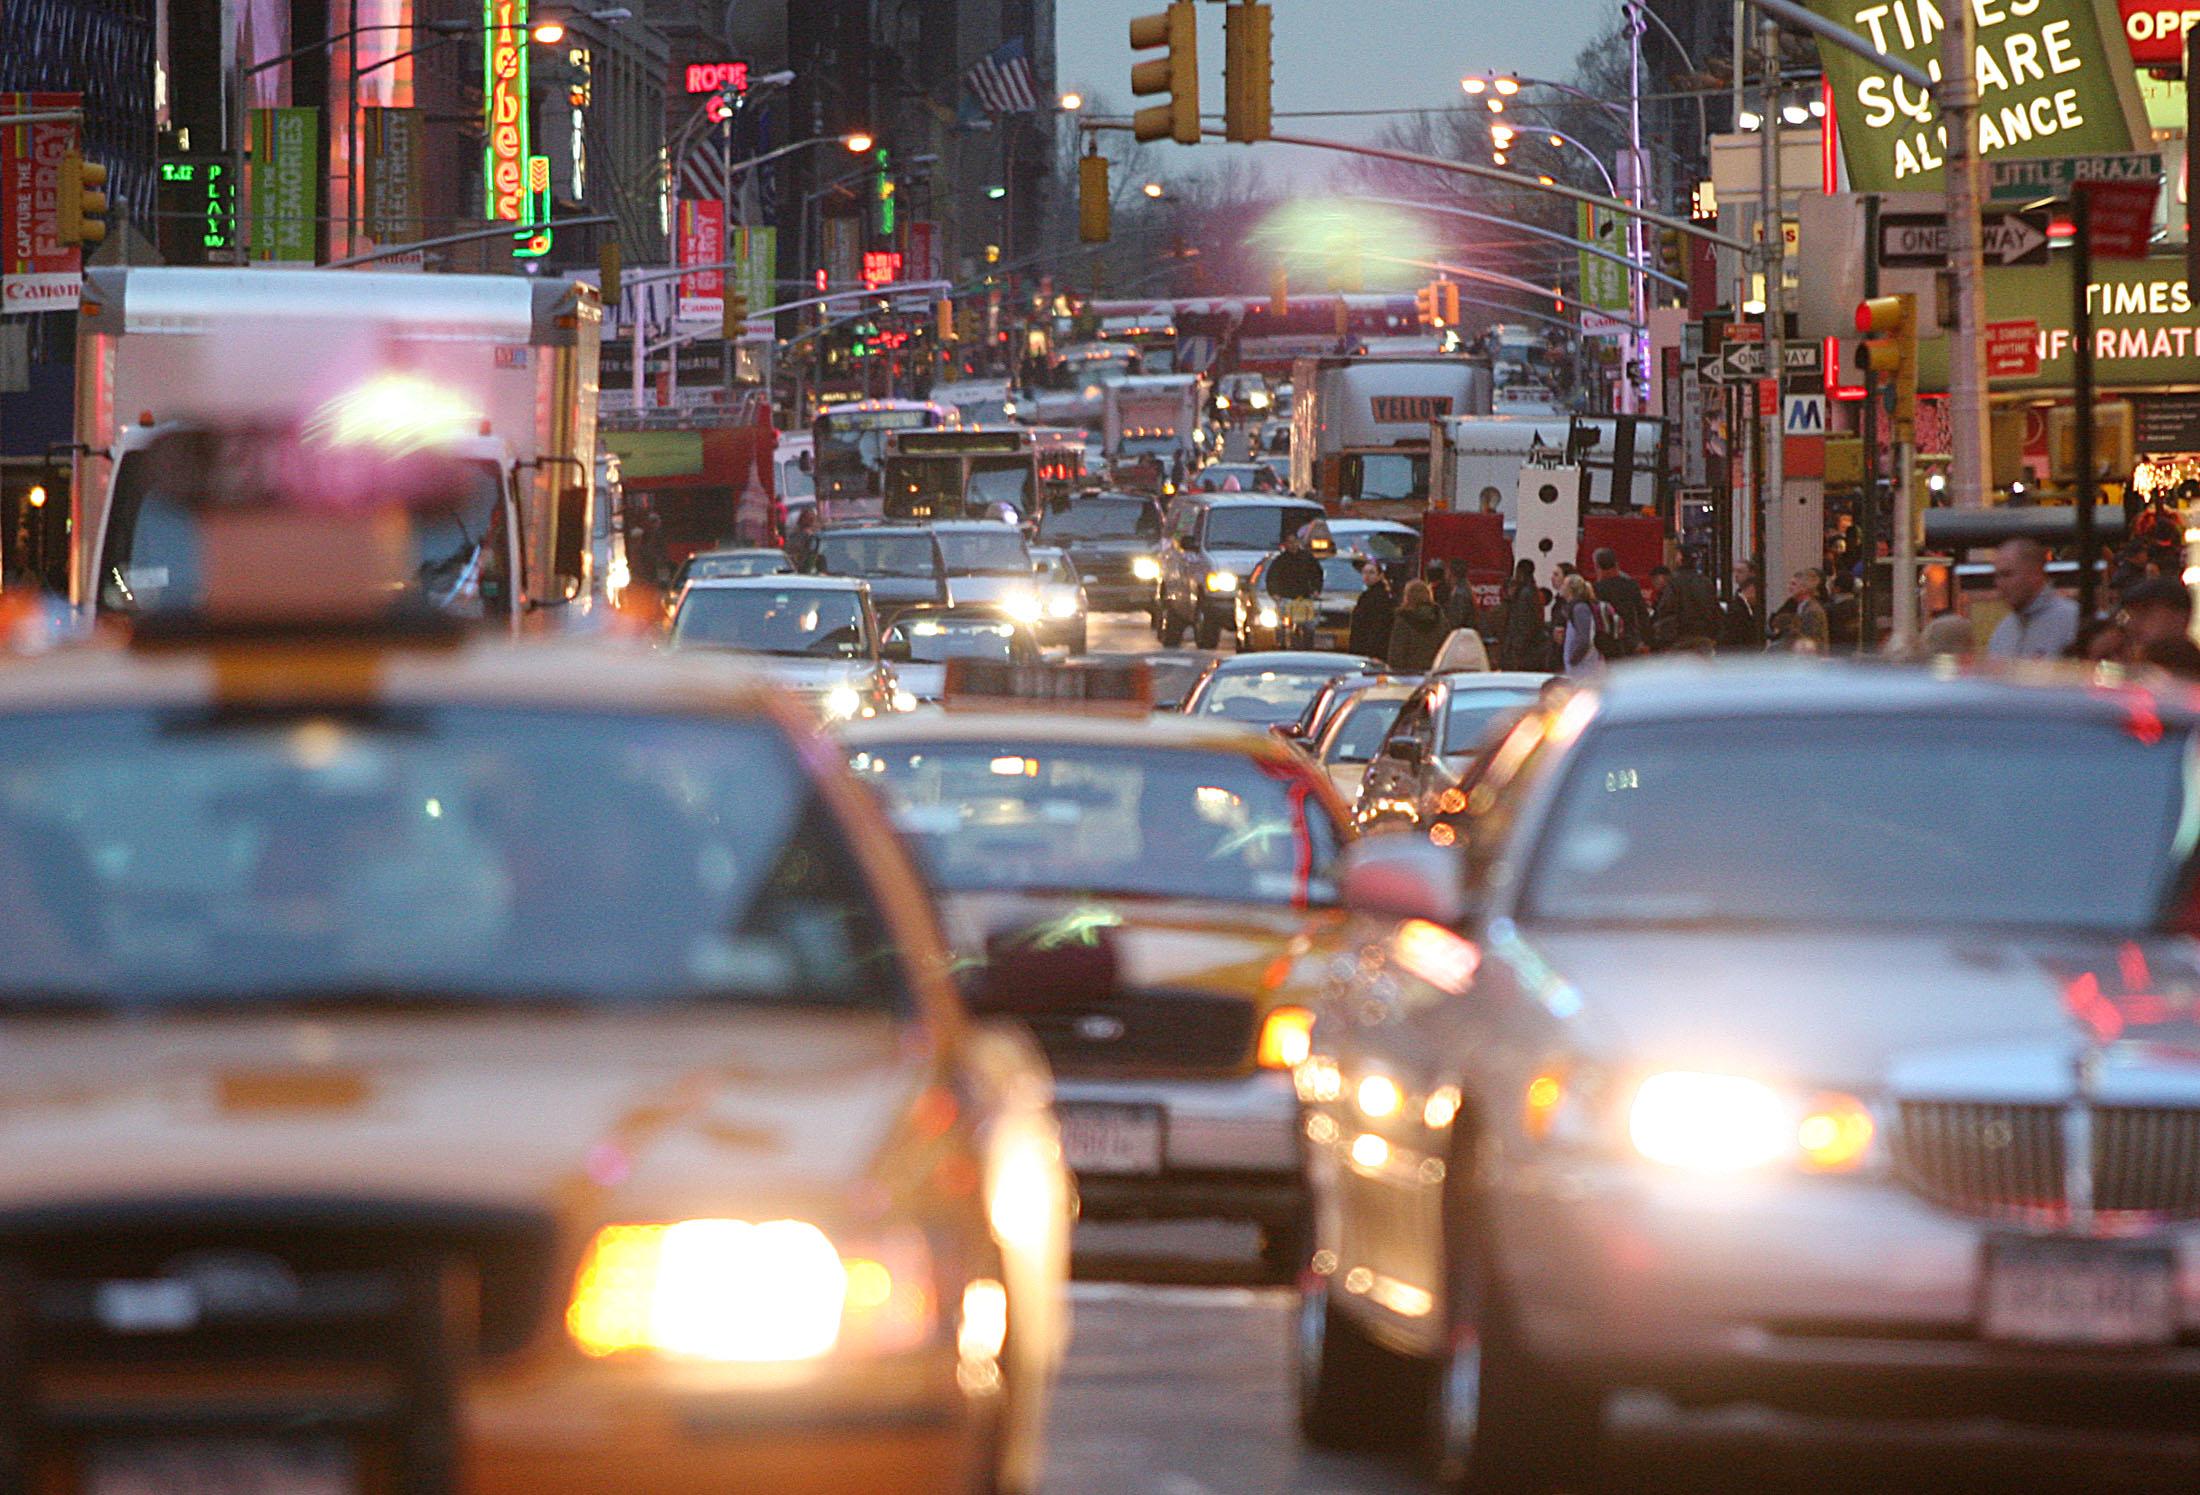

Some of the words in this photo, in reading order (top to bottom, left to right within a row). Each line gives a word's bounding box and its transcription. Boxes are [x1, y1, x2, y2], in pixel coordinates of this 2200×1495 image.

[1857, 19, 2081, 127] SQARE
[1895, 88, 2083, 179] ALANCE
[18, 162, 31, 188] THE
[280, 116, 303, 248] MEMORIES
[1991, 160, 2065, 186] LITTLE
[2074, 153, 2159, 181] BRAZIL
[17, 193, 32, 257] CAPTURE
[1903, 226, 1947, 249] ONE
[1983, 222, 2028, 248] WAY
[6, 281, 80, 301] Canon
[1740, 352, 1764, 366] ON
[2036, 327, 2200, 361] NFRMATI
